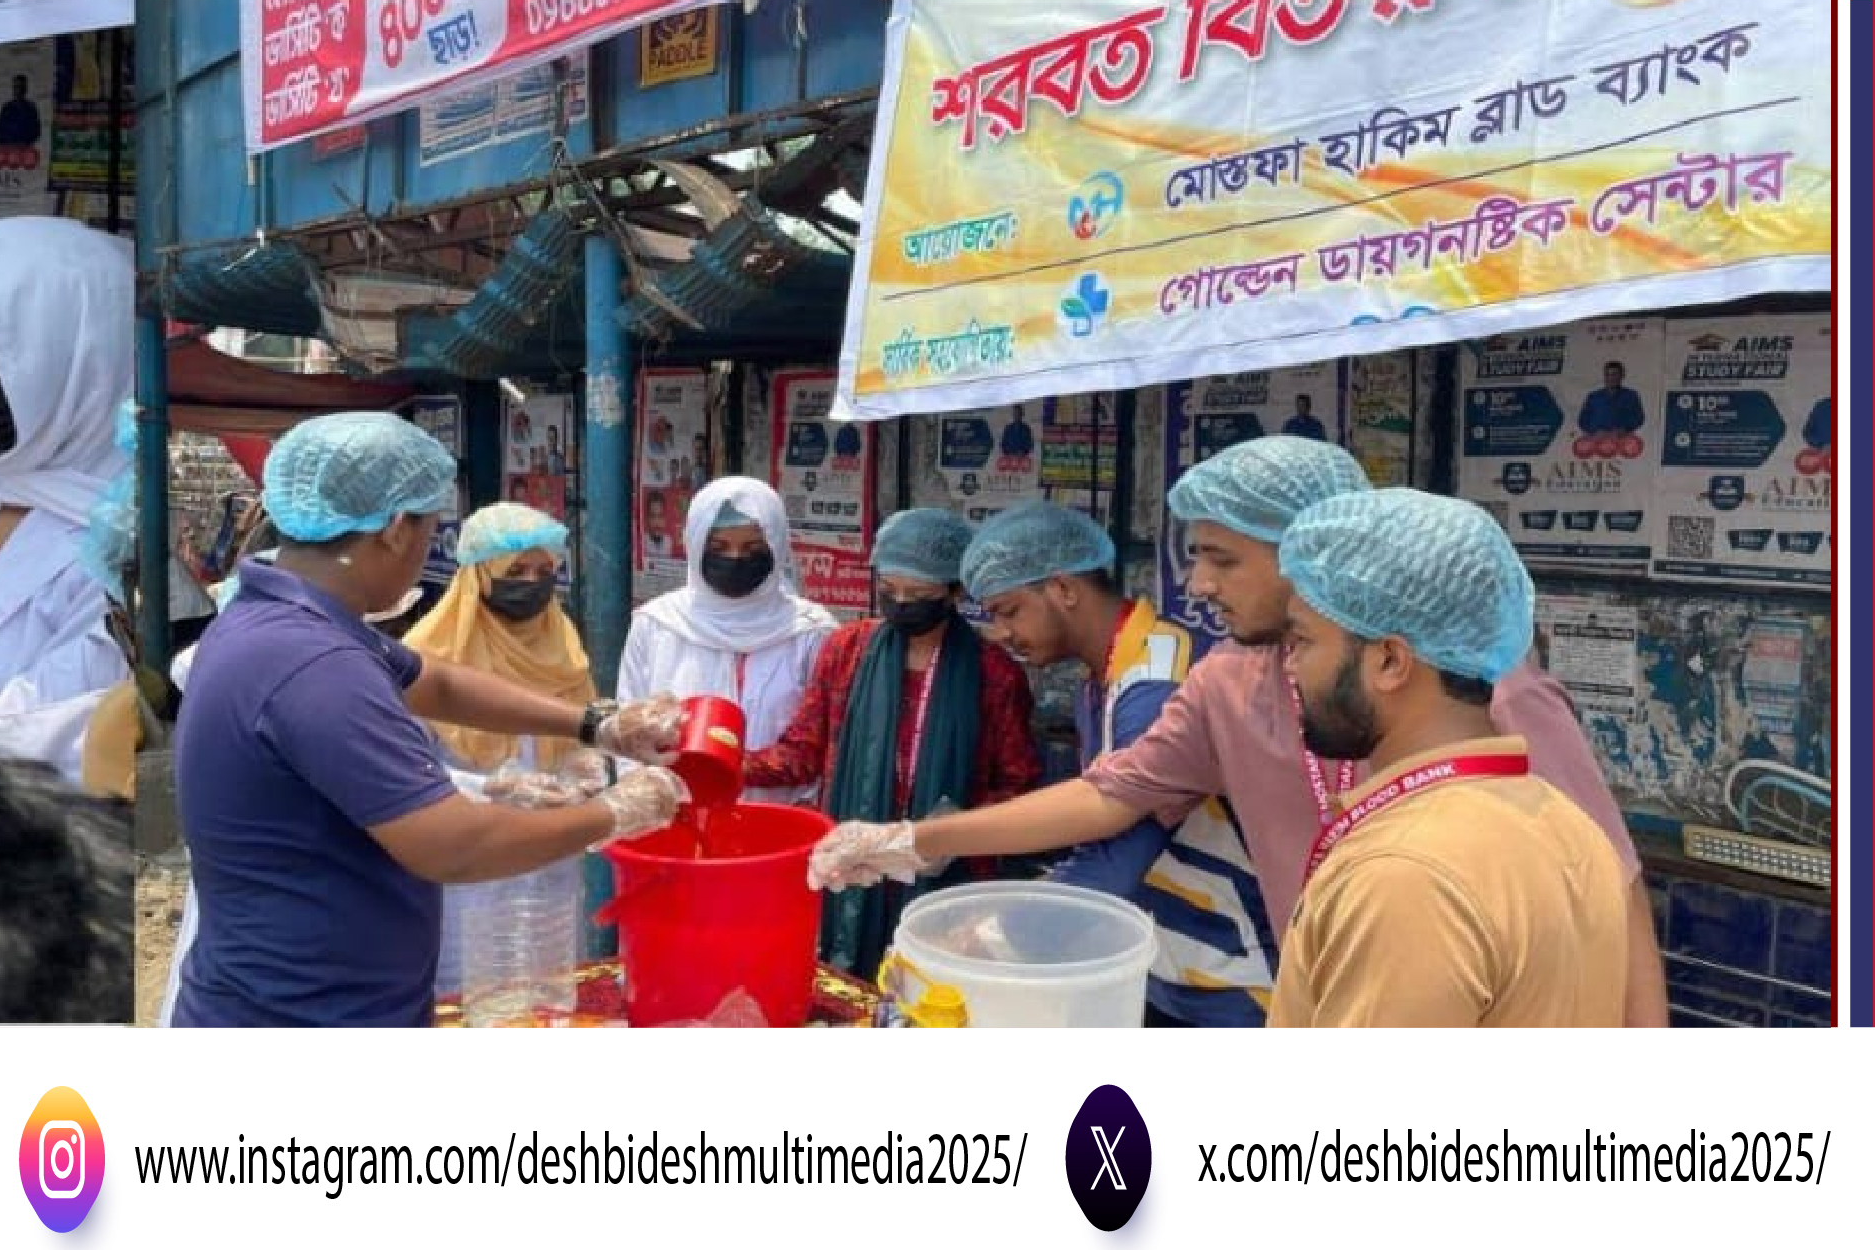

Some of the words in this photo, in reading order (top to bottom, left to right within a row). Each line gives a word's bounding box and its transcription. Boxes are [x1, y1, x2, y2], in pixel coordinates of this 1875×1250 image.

[427, 8, 480, 65] ছাড়!
[931, 4, 1167, 149] শরবত
[1165, 137, 1303, 210] মোস্তফা
[1319, 105, 1460, 174] হাকিম
[1469, 74, 1576, 144] ব্লাড
[1592, 21, 1760, 107] ব্যাংক
[904, 212, 1018, 265] আয়োজনে:
[1158, 252, 1303, 316] গোল্ডেন
[1590, 149, 1795, 233] সেন্টার
[1517, 335, 1567, 352] AIMS
[1731, 335, 1794, 352] AIMS
[1686, 364, 1740, 378] STUDY
[1743, 363, 1784, 377] FAIR
[1548, 460, 1623, 479] AIMS
[1769, 476, 1831, 496] AIM
[1350, 784, 1401, 822] BLOOD
[1402, 763, 1456, 791] BANK
